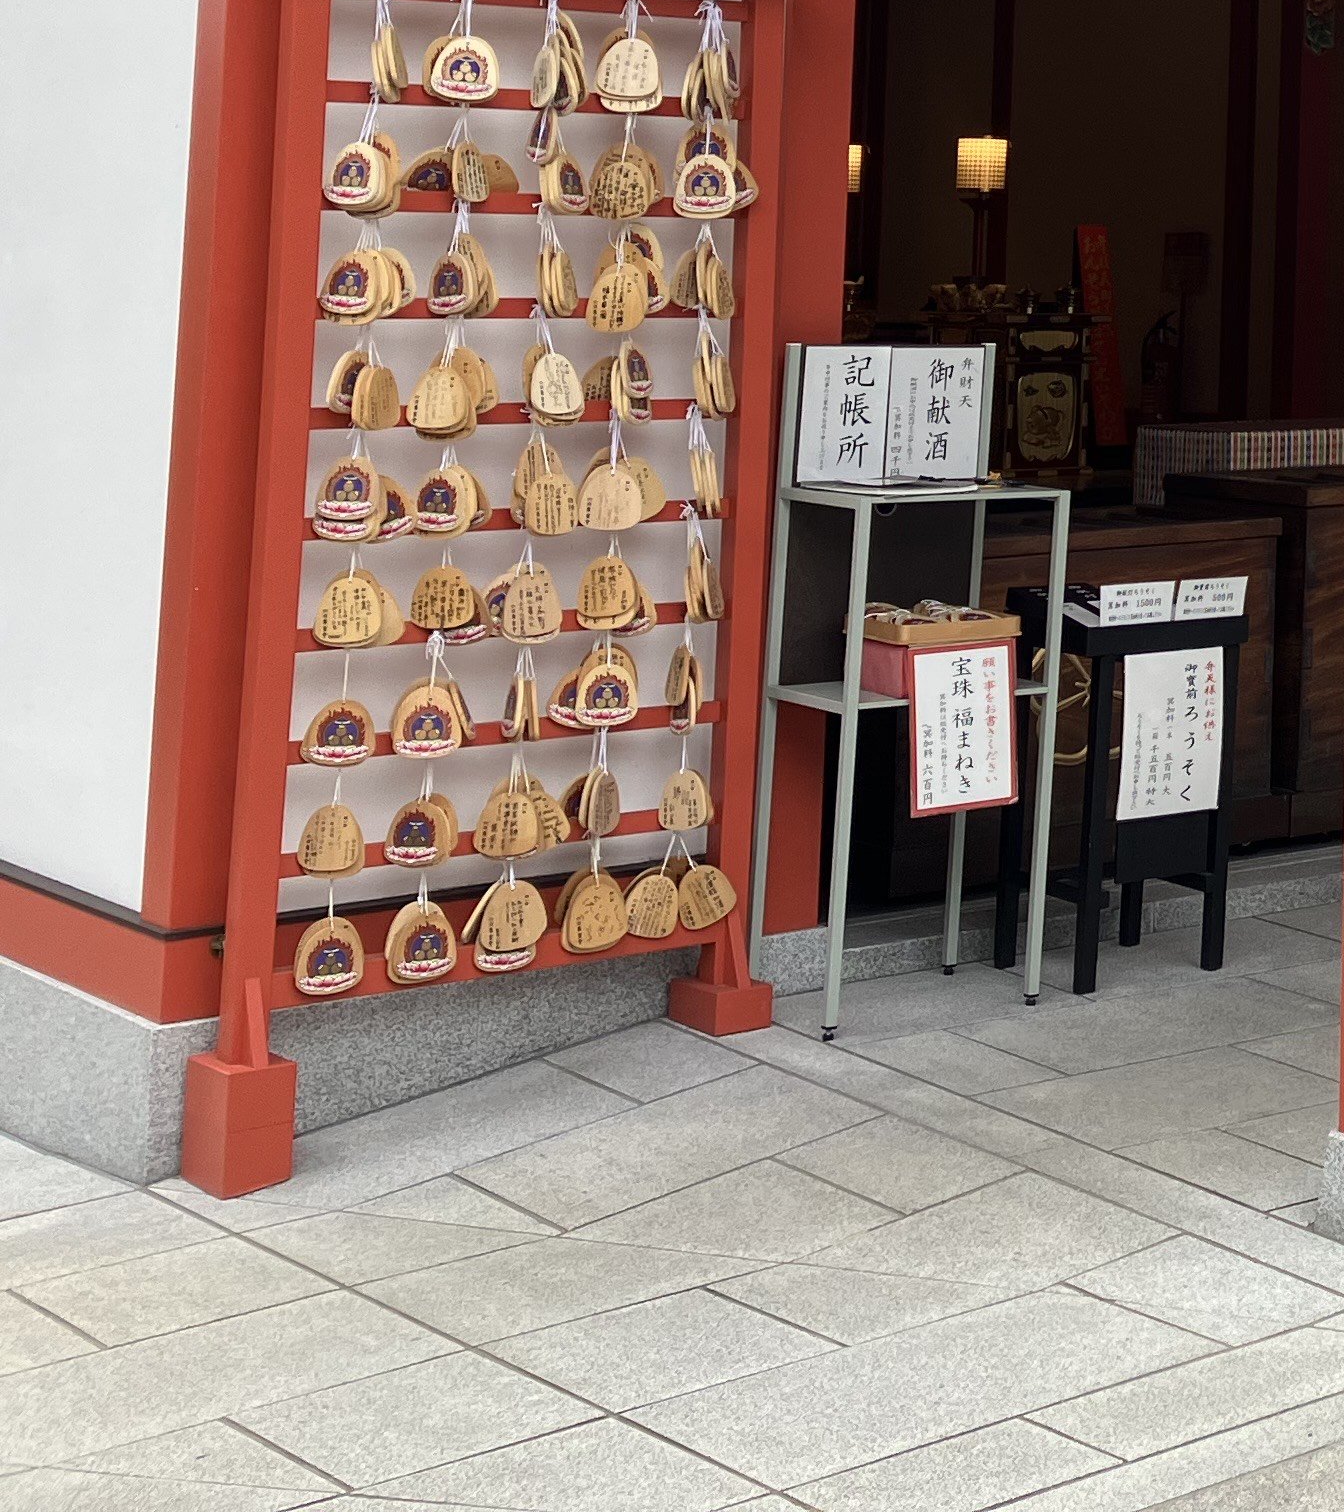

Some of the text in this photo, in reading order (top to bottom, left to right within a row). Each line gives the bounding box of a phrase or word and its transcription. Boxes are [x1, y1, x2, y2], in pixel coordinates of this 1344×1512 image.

[836, 354, 875, 469] 記帳所
[925, 358, 954, 462] 御献酒
[958, 357, 975, 408] 弁財天
